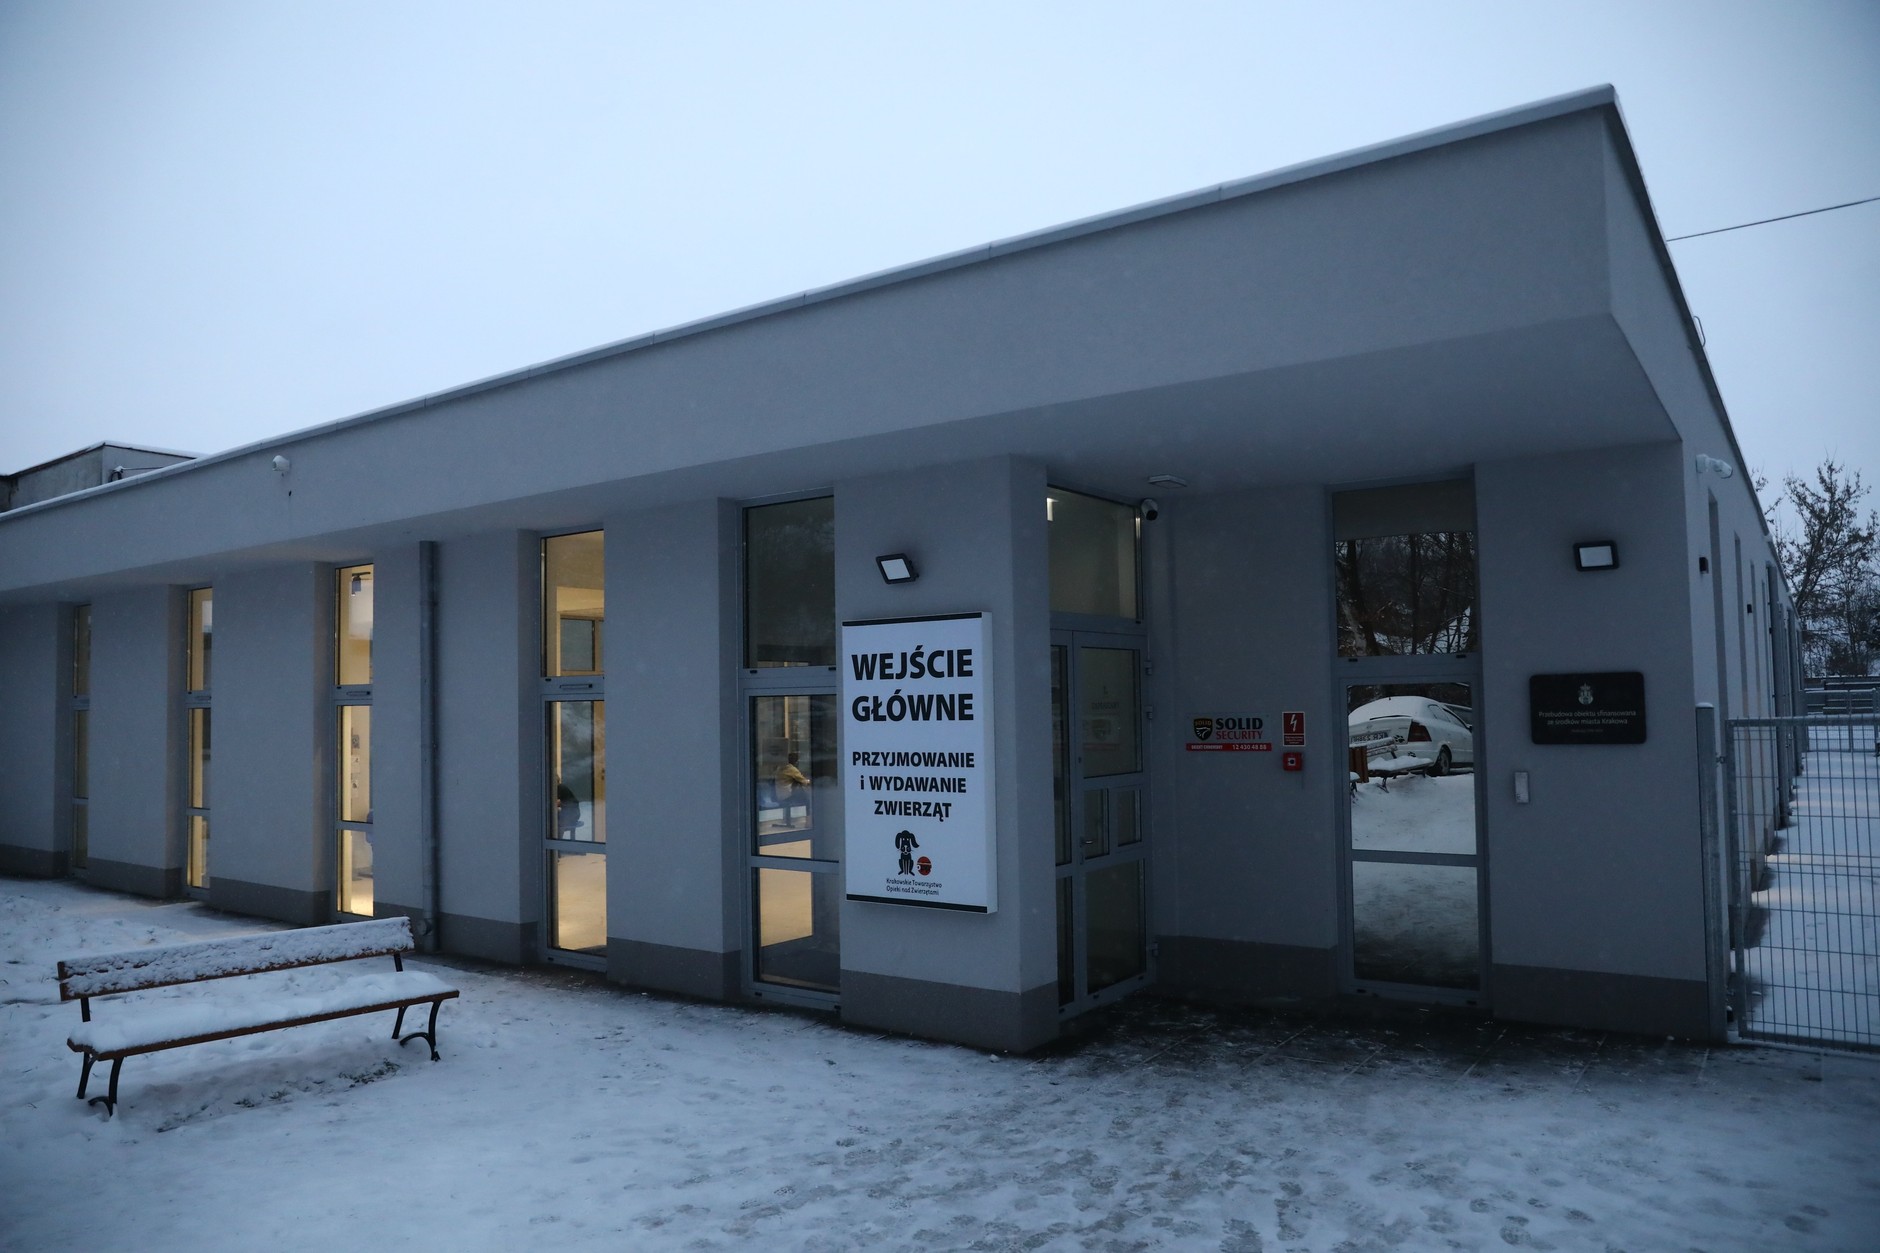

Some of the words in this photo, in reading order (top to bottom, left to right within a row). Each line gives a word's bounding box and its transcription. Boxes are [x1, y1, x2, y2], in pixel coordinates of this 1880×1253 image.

[851, 645, 973, 681] WEJŚCIE
[852, 689, 974, 722] GŁÓWNE
[1215, 717, 1263, 730] SOLID
[1216, 730, 1264, 740] SECURITY
[852, 751, 975, 768] PRZYJMOWANIE
[860, 775, 865, 790] i
[869, 776, 967, 793] WYDAWANIE
[874, 800, 952, 822] ZWIERZĄT
[912, 880, 942, 888] Towarzystwo
